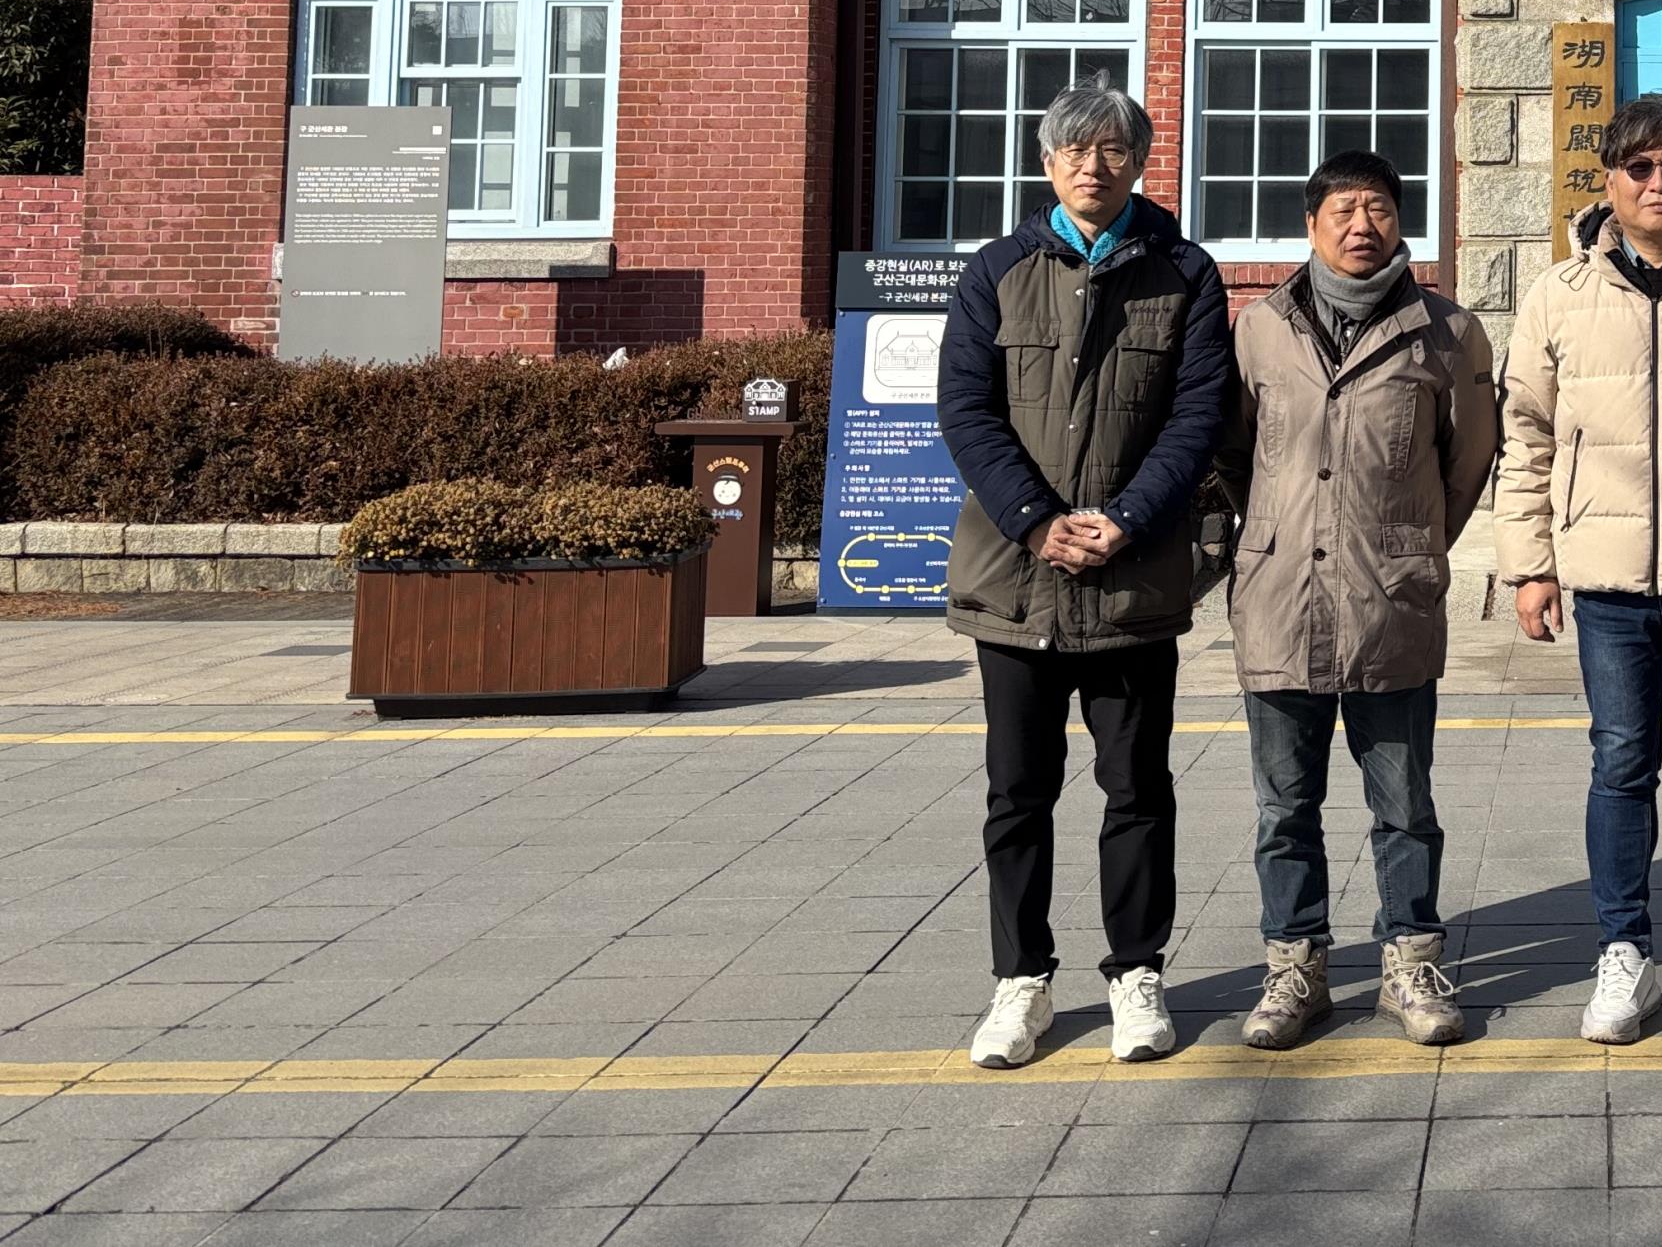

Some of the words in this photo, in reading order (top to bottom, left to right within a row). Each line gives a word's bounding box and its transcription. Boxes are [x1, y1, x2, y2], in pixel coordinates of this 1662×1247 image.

[1562, 39, 1606, 225] 湖南關稅
[864, 259, 945, 272] 증강현실(AR)로
[948, 260, 968, 272] 보는
[748, 406, 780, 416] STAMP
